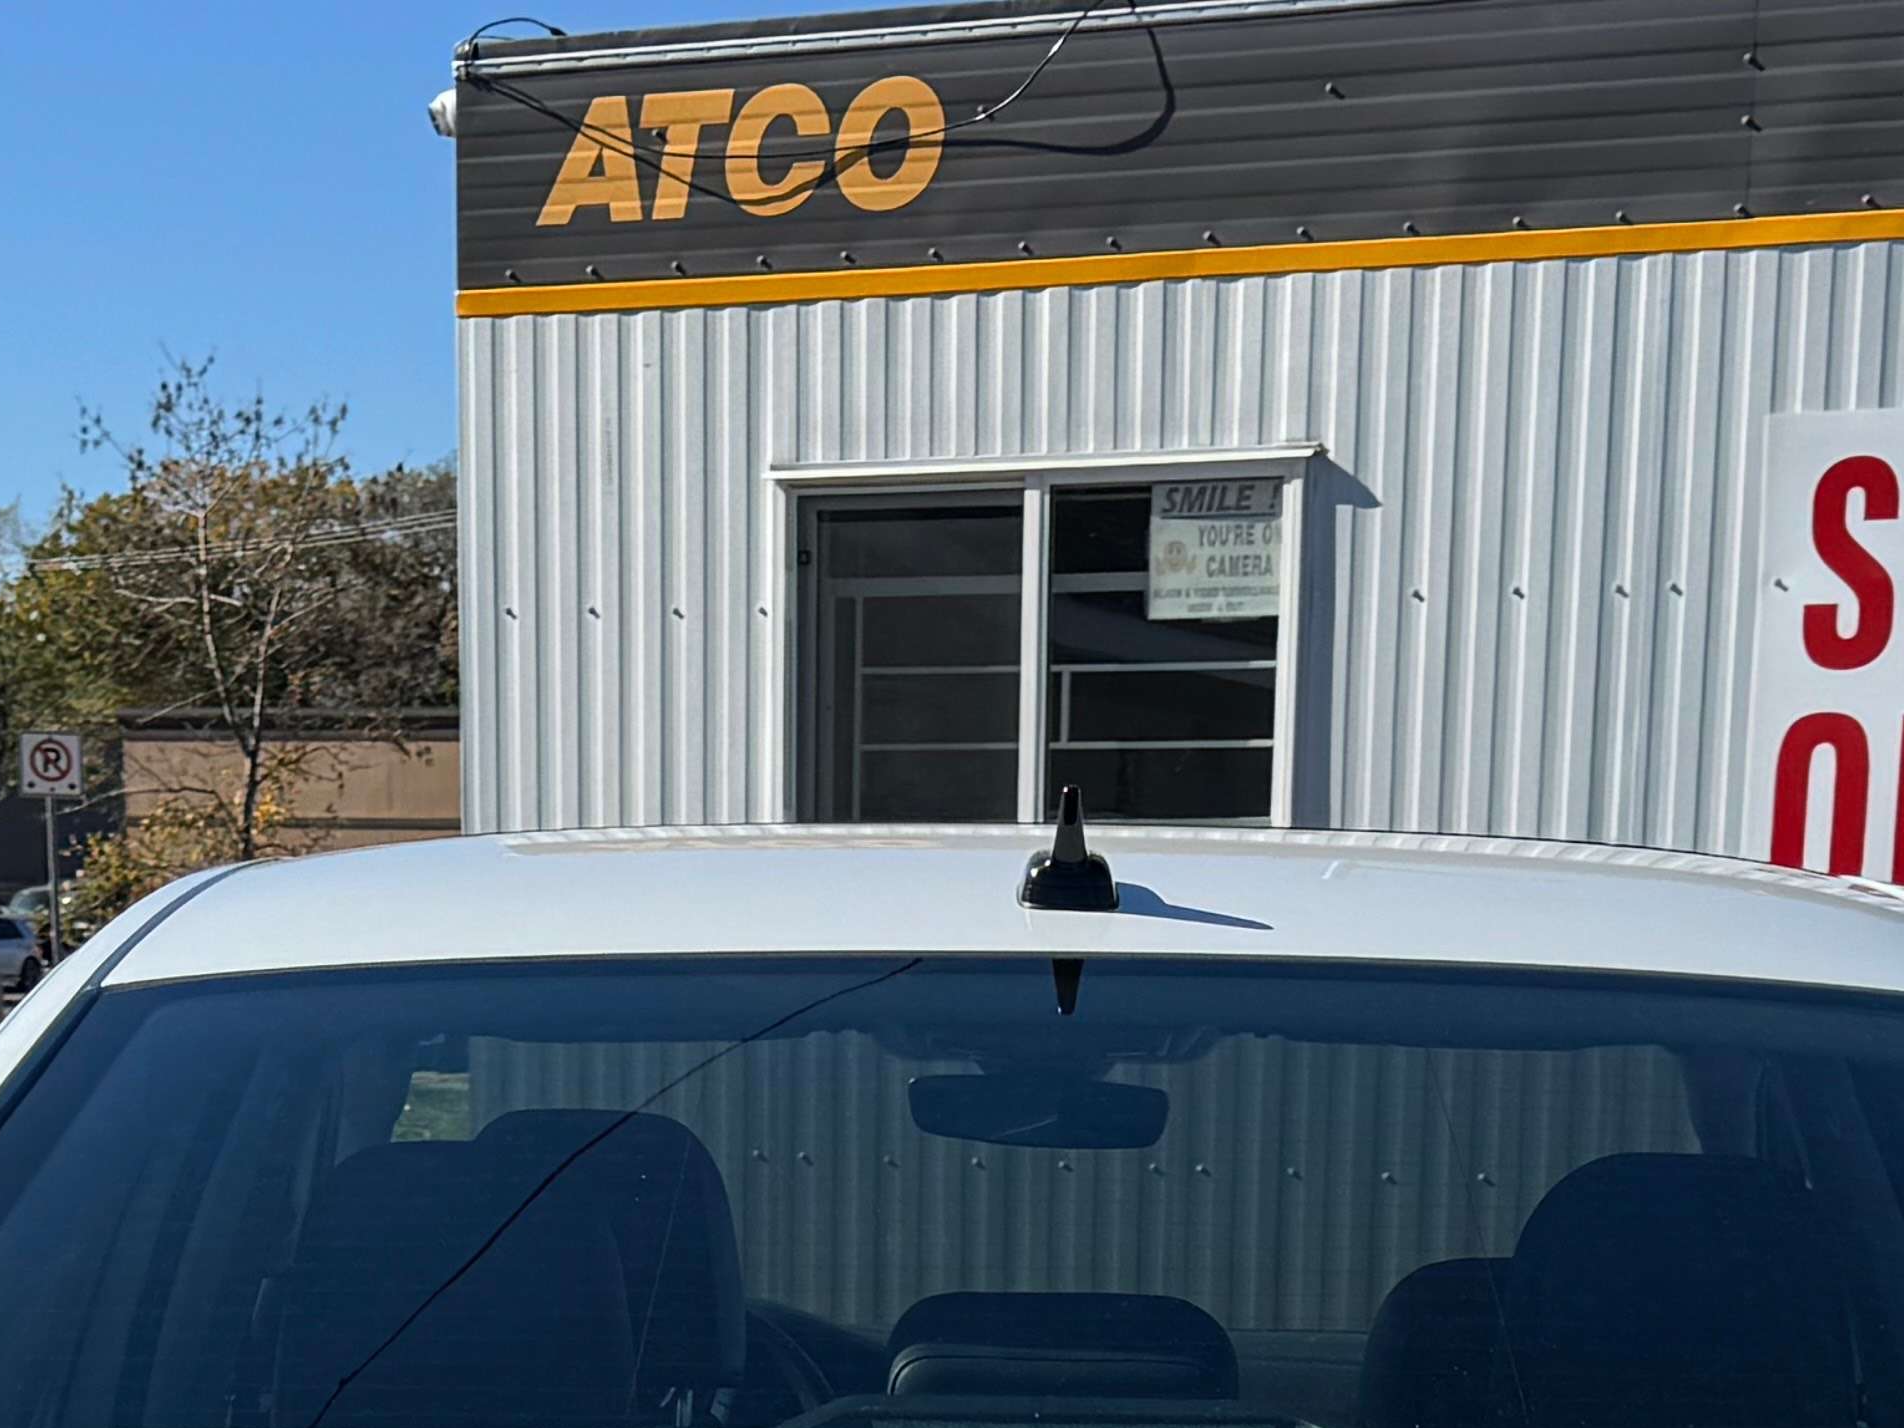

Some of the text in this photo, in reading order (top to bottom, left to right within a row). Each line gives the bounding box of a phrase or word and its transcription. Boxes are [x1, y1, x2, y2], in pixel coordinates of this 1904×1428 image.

[535, 75, 945, 226] ATCO
[1161, 484, 1256, 513] SMILE
[1198, 524, 1255, 547] YOU'RE
[1205, 553, 1273, 578] CAMERA
